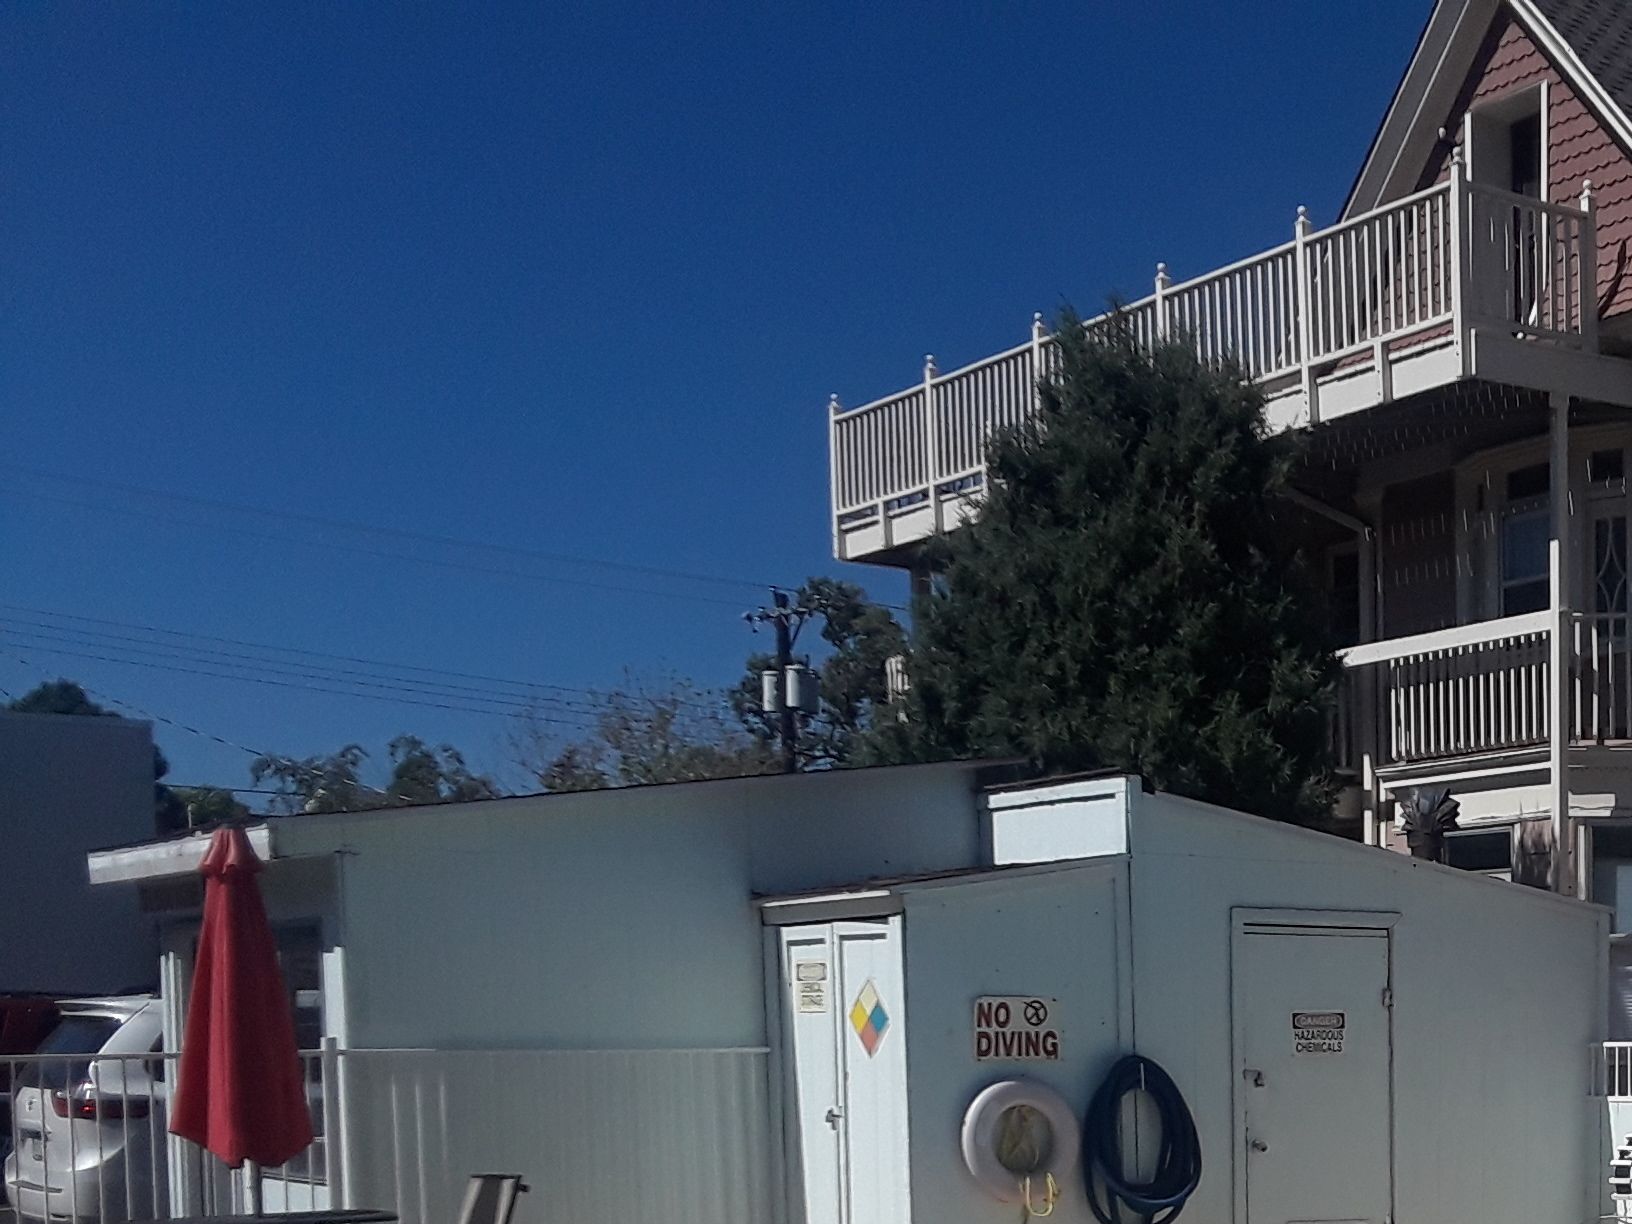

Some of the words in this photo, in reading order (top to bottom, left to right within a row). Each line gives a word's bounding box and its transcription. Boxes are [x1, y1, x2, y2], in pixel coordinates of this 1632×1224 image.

[977, 1002, 1010, 1028] NO
[1294, 1030, 1343, 1041] HAZARDOUS
[977, 1031, 1058, 1059] DIVING
[1295, 1042, 1342, 1052] CHECALS
